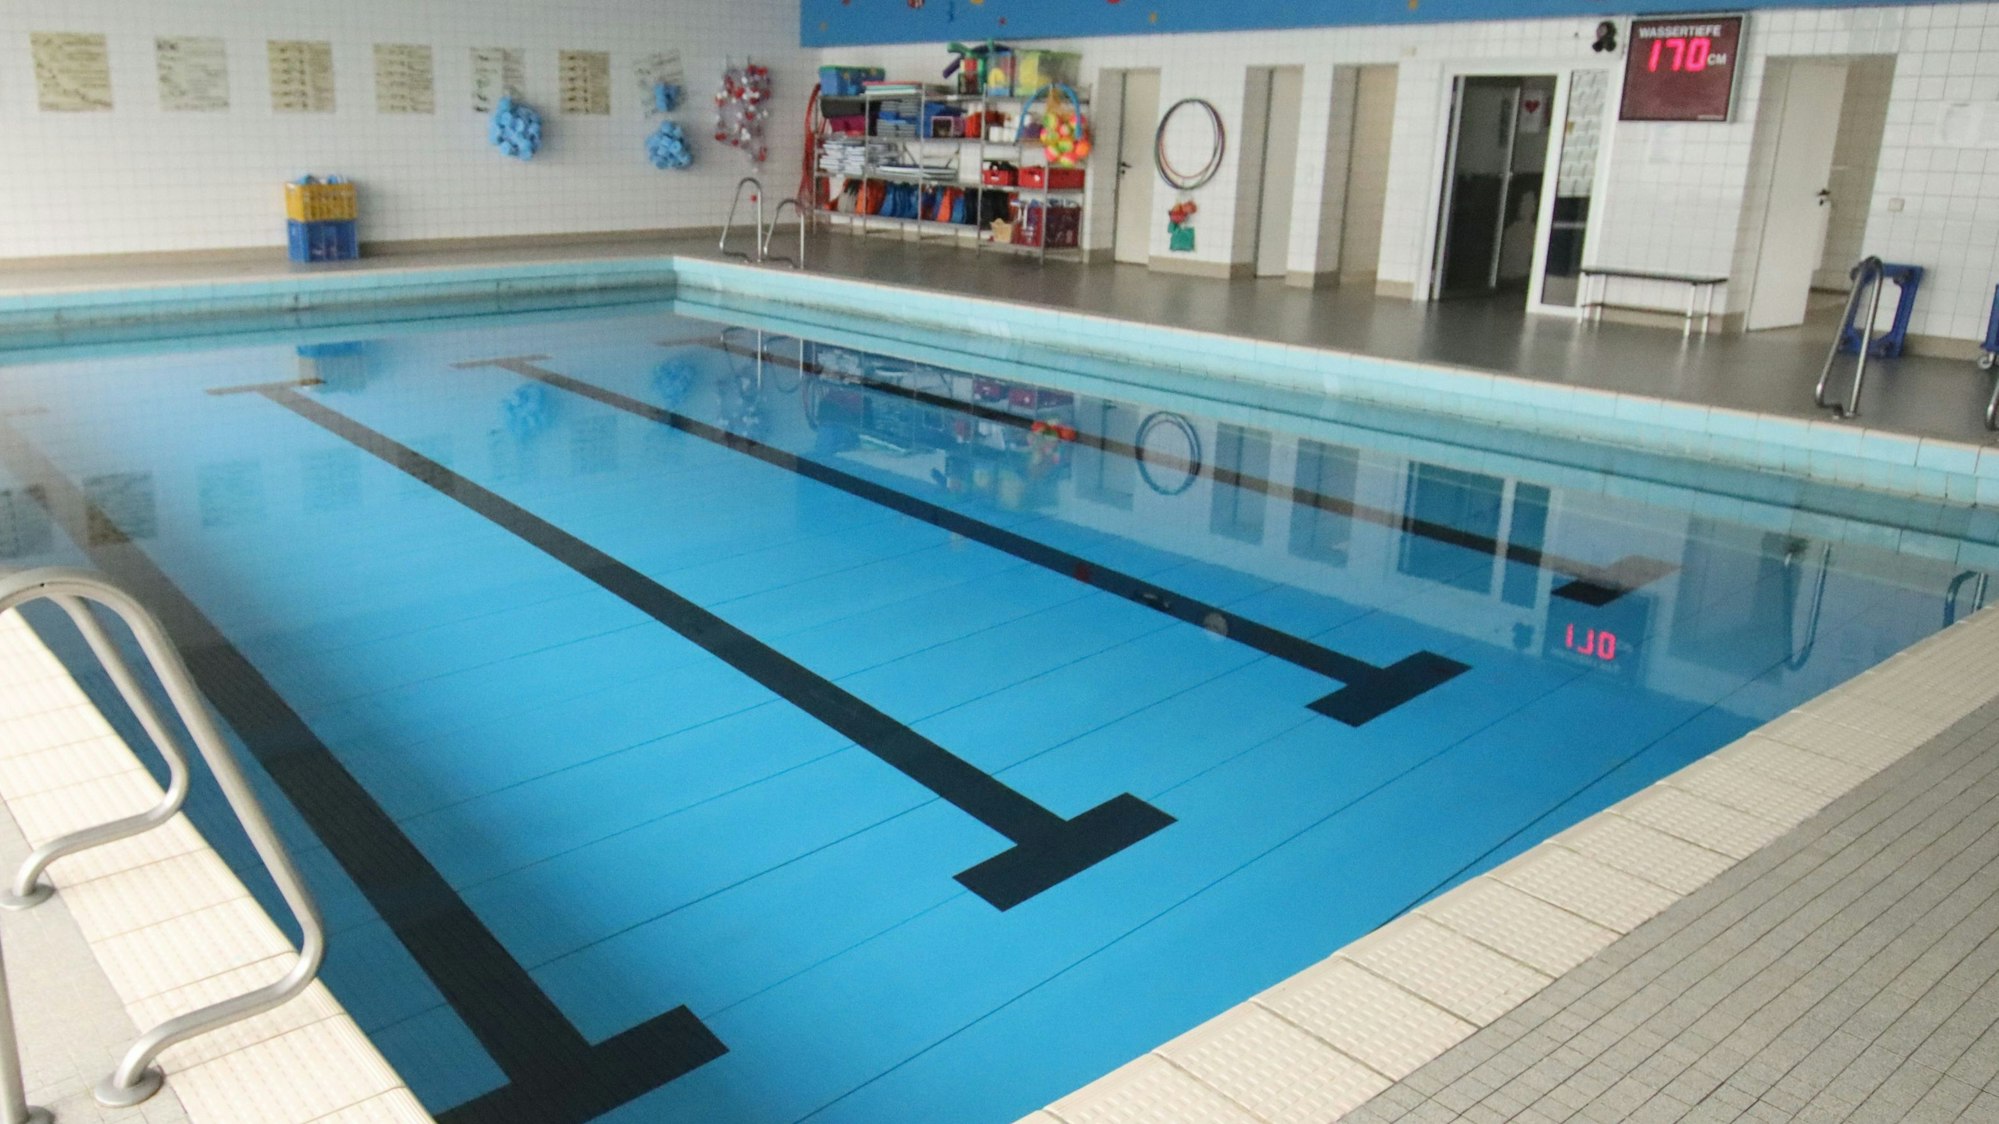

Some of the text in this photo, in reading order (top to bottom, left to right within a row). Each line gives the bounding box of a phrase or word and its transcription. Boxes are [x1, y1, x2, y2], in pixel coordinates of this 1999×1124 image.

[1640, 25, 1720, 38] WASSERTIEFE
[1648, 36, 1727, 72] 170 CM
